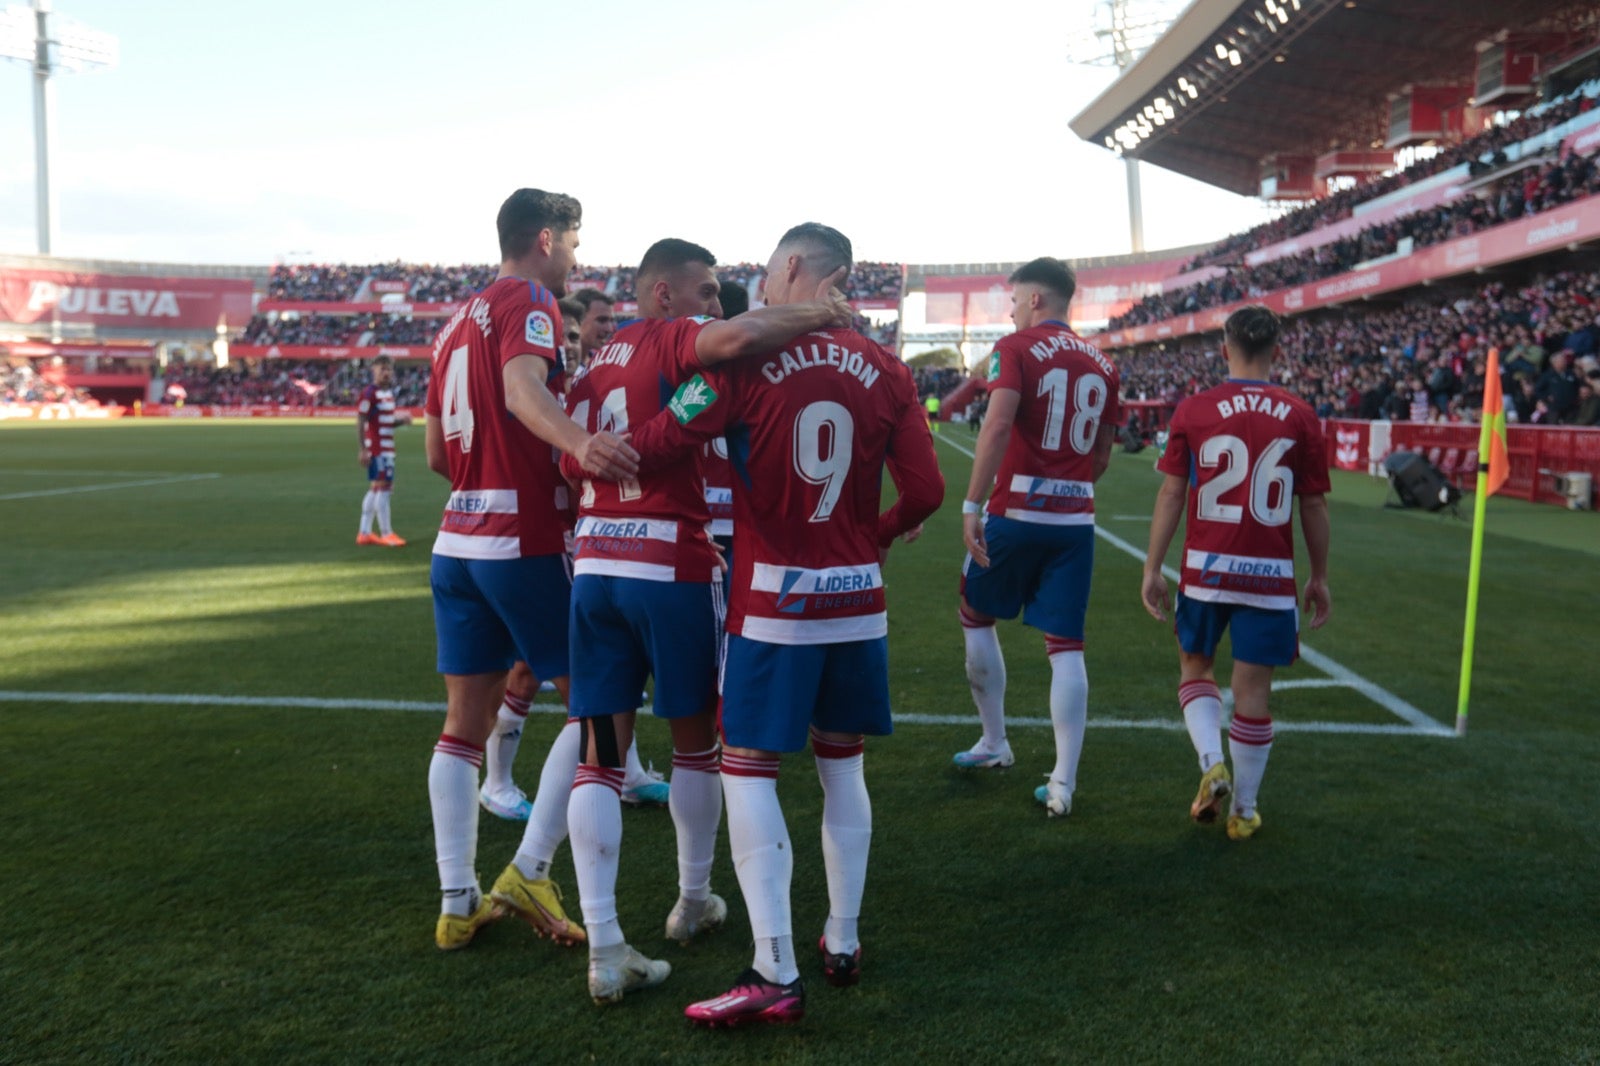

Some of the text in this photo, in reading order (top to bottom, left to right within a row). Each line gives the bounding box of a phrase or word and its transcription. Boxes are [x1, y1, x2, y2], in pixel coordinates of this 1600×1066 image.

[27, 280, 181, 318] PULEVA
[761, 343, 880, 390] CALLEJÓN
[441, 344, 475, 455] 4
[1037, 366, 1108, 455] 18
[1217, 394, 1292, 421] BRYAN
[793, 400, 854, 523] 9
[1197, 434, 1297, 527] 26
[1052, 484, 1089, 497] LIDERA
[589, 521, 648, 537] LIDERA
[814, 572, 874, 592] LIDERA
[1228, 559, 1281, 577] LIDERA
